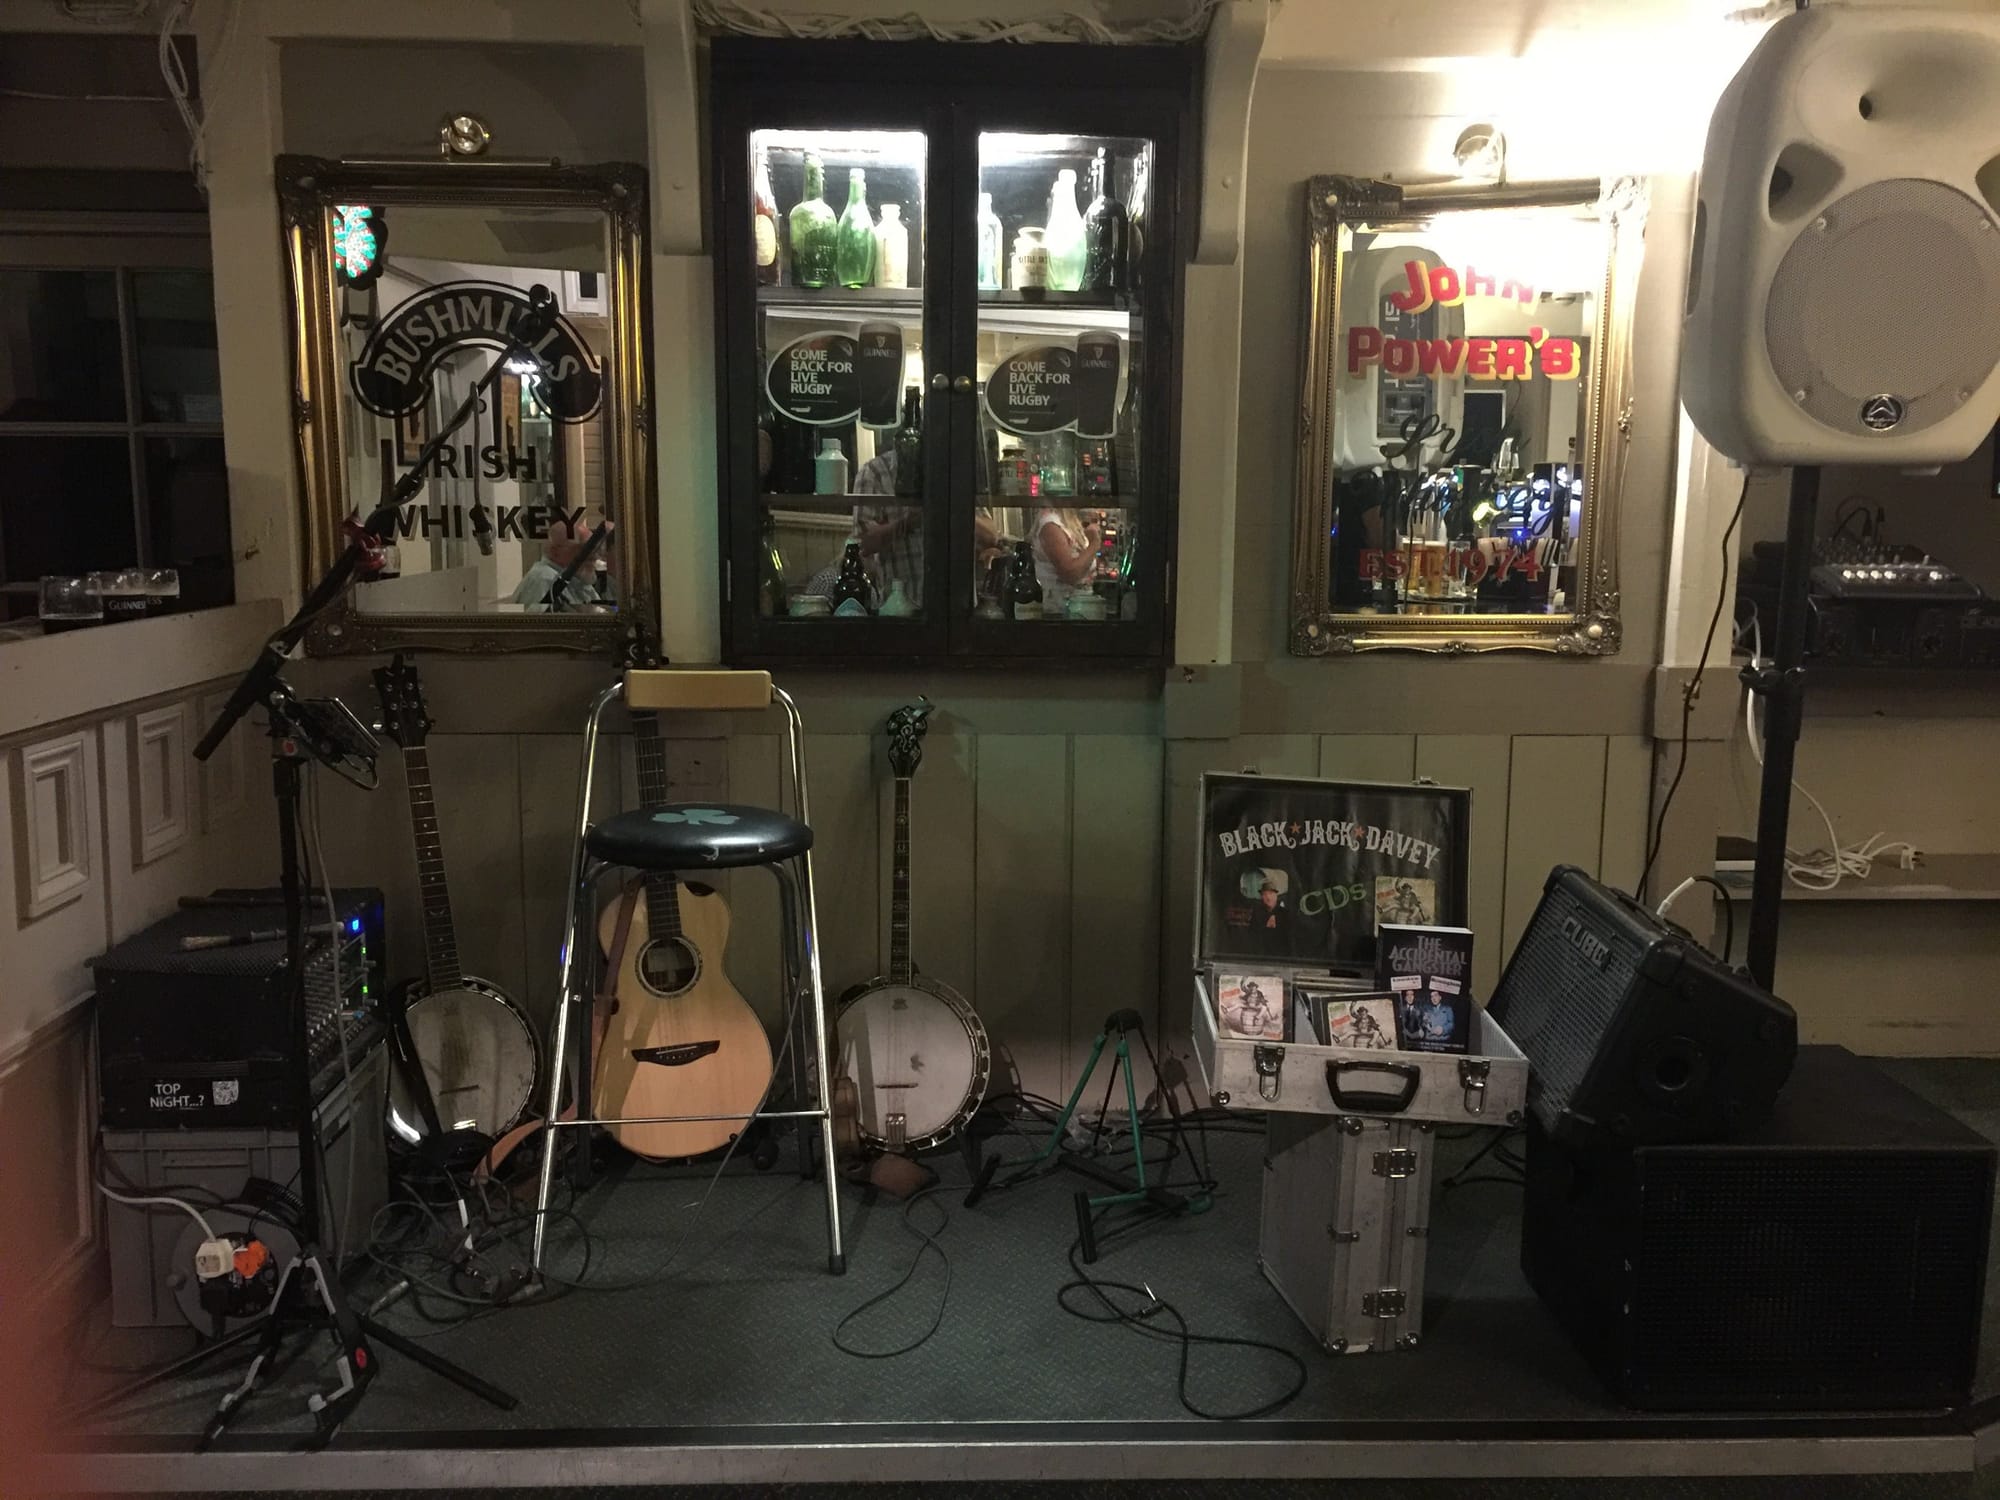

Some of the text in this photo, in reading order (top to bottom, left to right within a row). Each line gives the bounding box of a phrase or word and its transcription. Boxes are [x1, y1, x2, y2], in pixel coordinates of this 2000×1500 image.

[374, 295, 580, 385] BUSHMILS
[790, 348, 828, 361] COME
[1348, 325, 1580, 380] POWER'S
[790, 360, 854, 374] BACK FOR
[1009, 361, 1047, 373] COME
[790, 372, 819, 383] LIVE
[1009, 373, 1072, 385] BACK FOR
[790, 383, 833, 395] RUGBY
[1009, 383, 1037, 395] LIVE
[1008, 394, 1051, 406] RUGBY
[1219, 819, 1440, 870] BLACK JACK DAVEY
[1299, 882, 1367, 916] CDs
[1417, 935, 1442, 951] THE
[1388, 944, 1468, 966] ACCIDENTAL
[1392, 959, 1462, 976] GANGSTER
[154, 1083, 181, 1095] TOP
